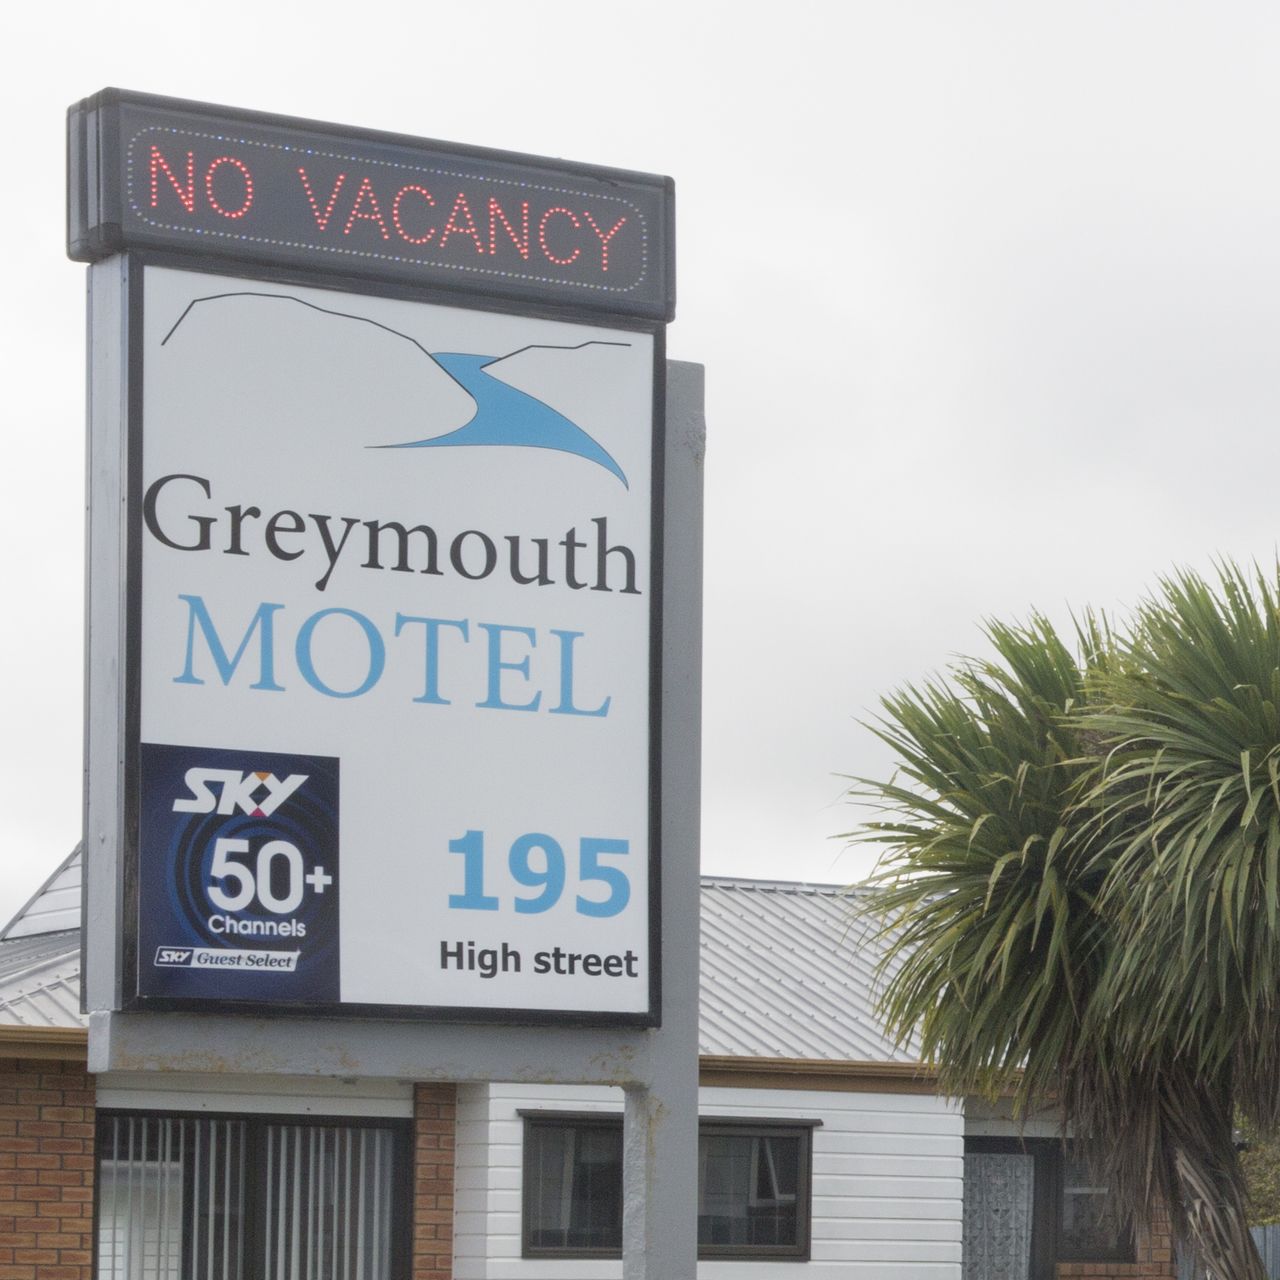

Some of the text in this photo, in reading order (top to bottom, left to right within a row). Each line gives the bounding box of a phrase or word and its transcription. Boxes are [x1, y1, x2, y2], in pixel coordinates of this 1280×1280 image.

[150, 144, 628, 272] NO VACANCY
[142, 473, 643, 595] Greymouth
[171, 593, 612, 718] MOTEL
[172, 766, 310, 817] SKY
[206, 837, 333, 915] 50+
[446, 829, 632, 919] 195
[158, 950, 293, 968] SKY Guest Select
[207, 914, 307, 938] Channels
[439, 940, 639, 979] High street
